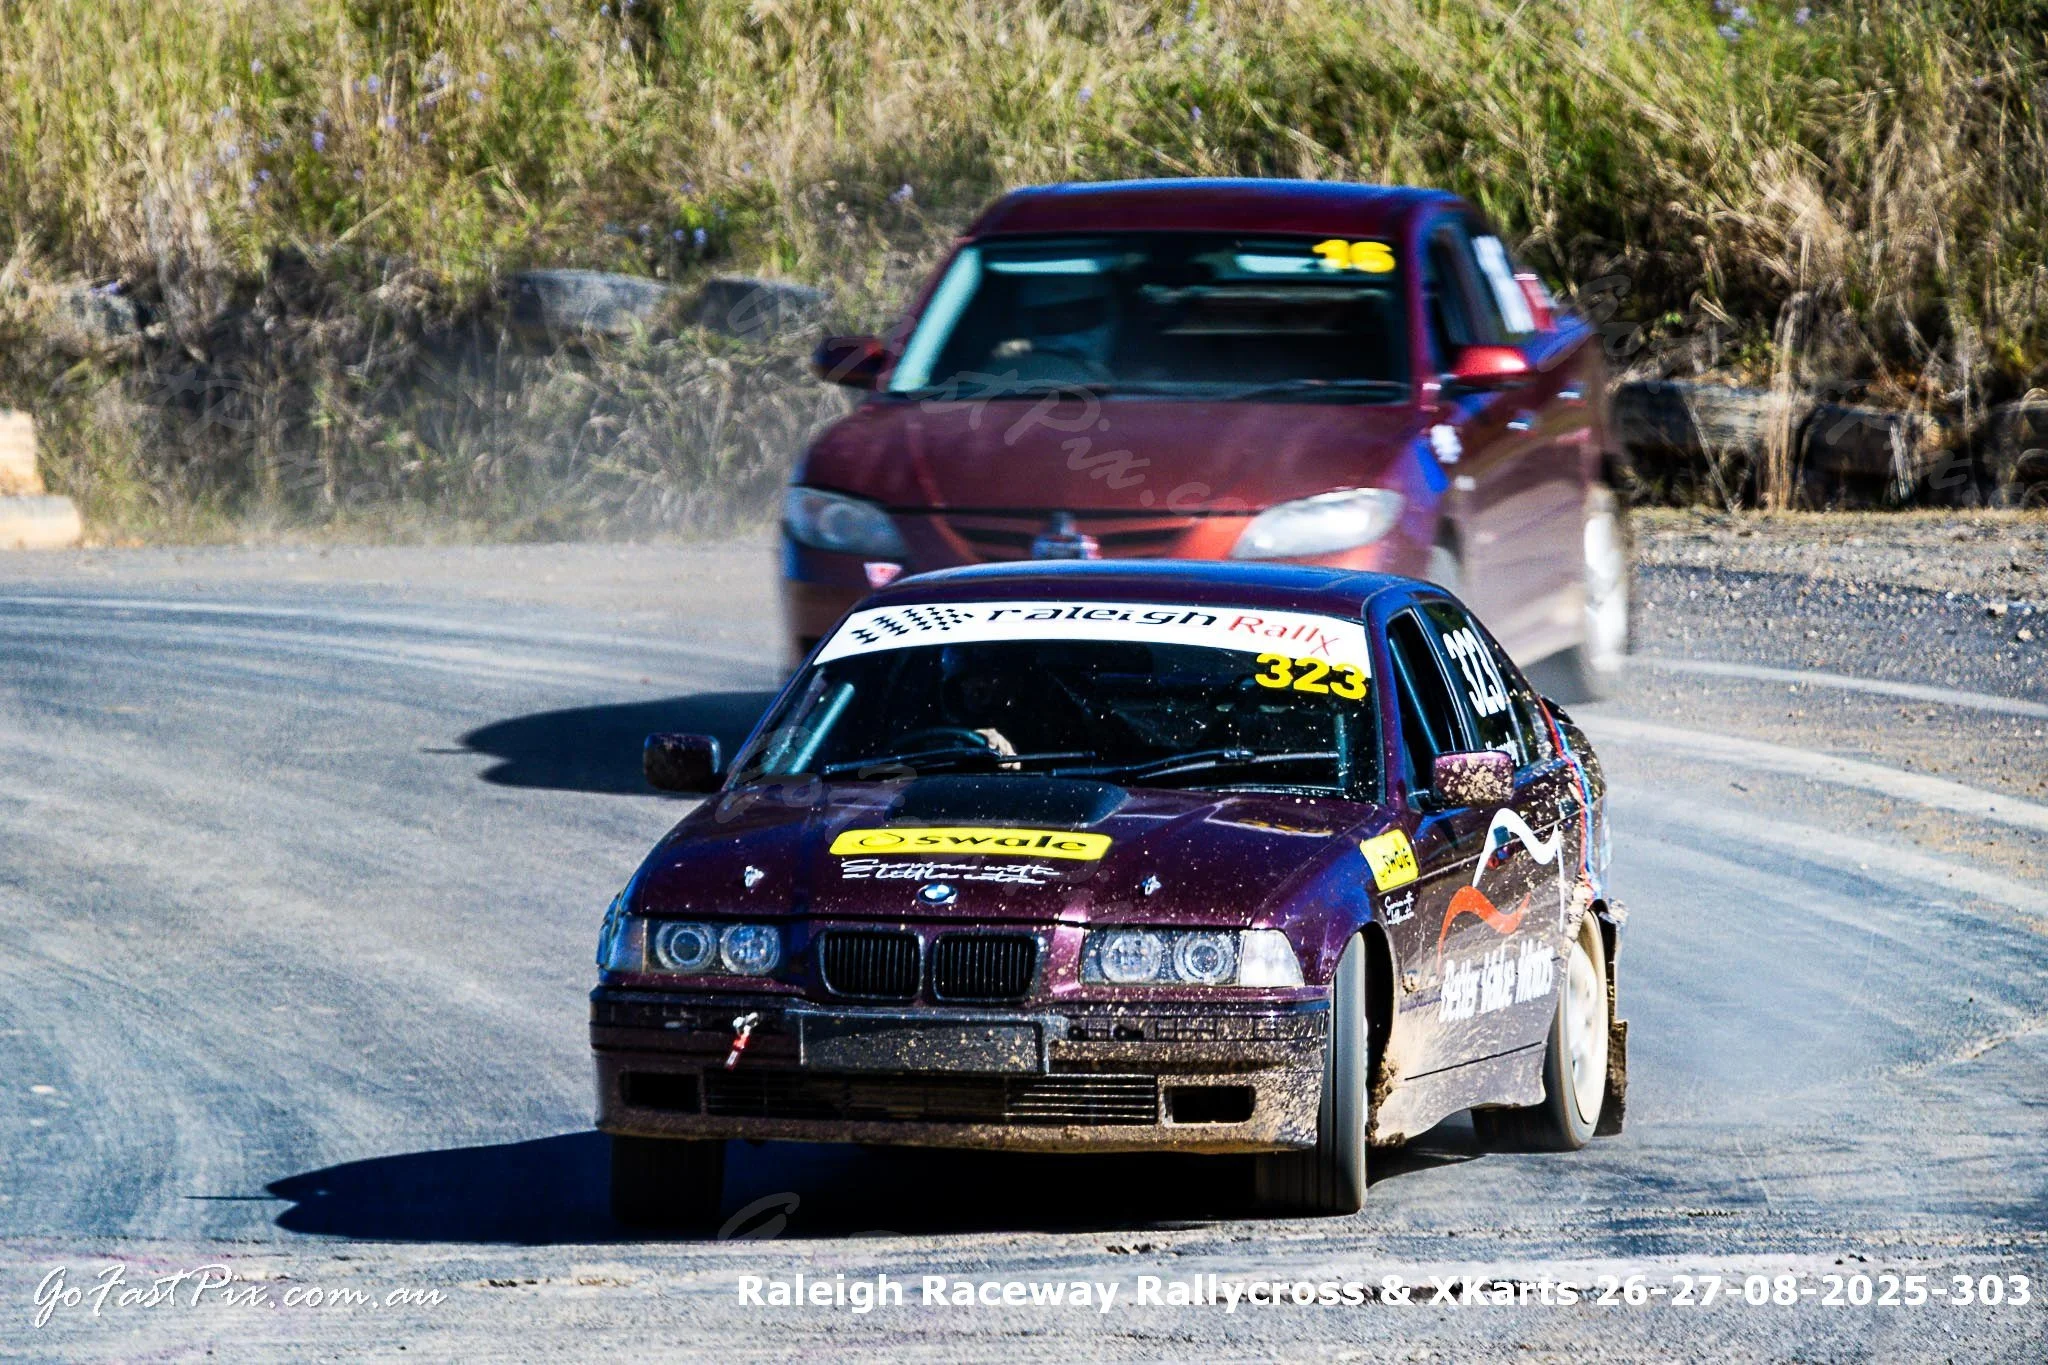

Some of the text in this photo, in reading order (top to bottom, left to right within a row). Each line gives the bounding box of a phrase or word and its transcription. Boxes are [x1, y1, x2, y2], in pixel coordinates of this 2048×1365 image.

[987, 606, 1218, 626] raleigh
[1255, 652, 1367, 700] 323
[1442, 627, 1507, 717] 323
[914, 834, 1088, 852] swale
